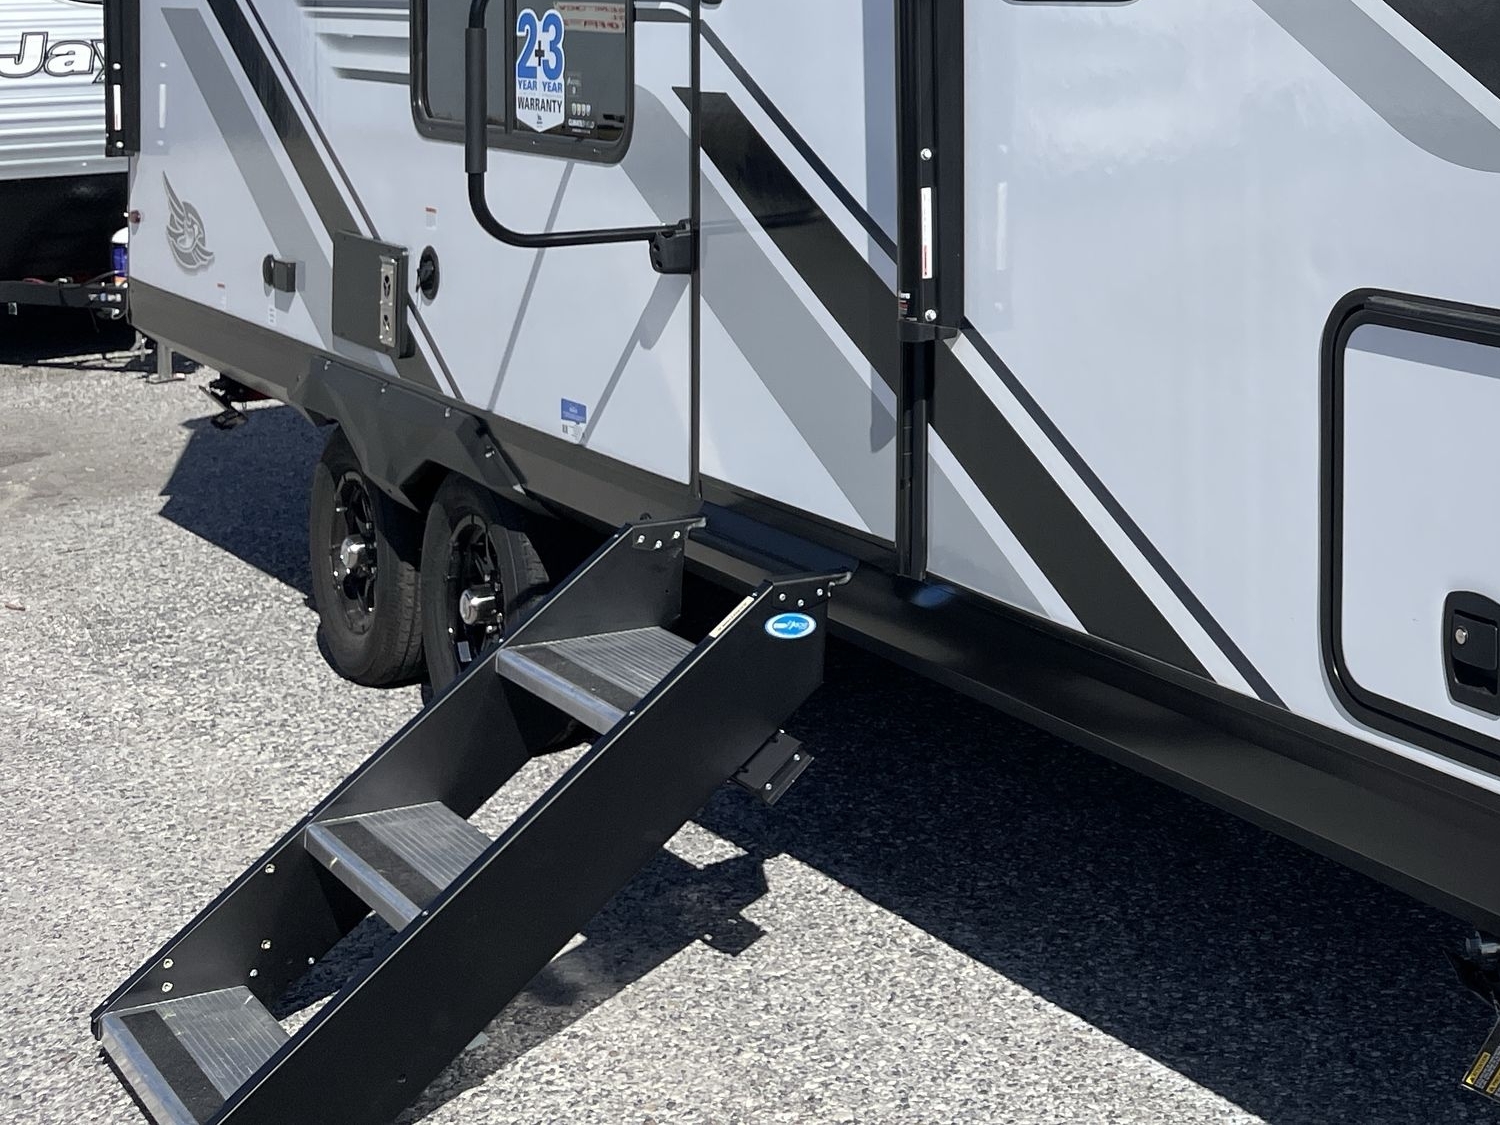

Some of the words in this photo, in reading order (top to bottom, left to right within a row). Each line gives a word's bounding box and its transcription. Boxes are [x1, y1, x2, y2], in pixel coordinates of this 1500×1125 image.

[517, 79, 538, 92] YEAR
[541, 81, 563, 94] YEAR
[517, 96, 563, 114] WARRANTY
